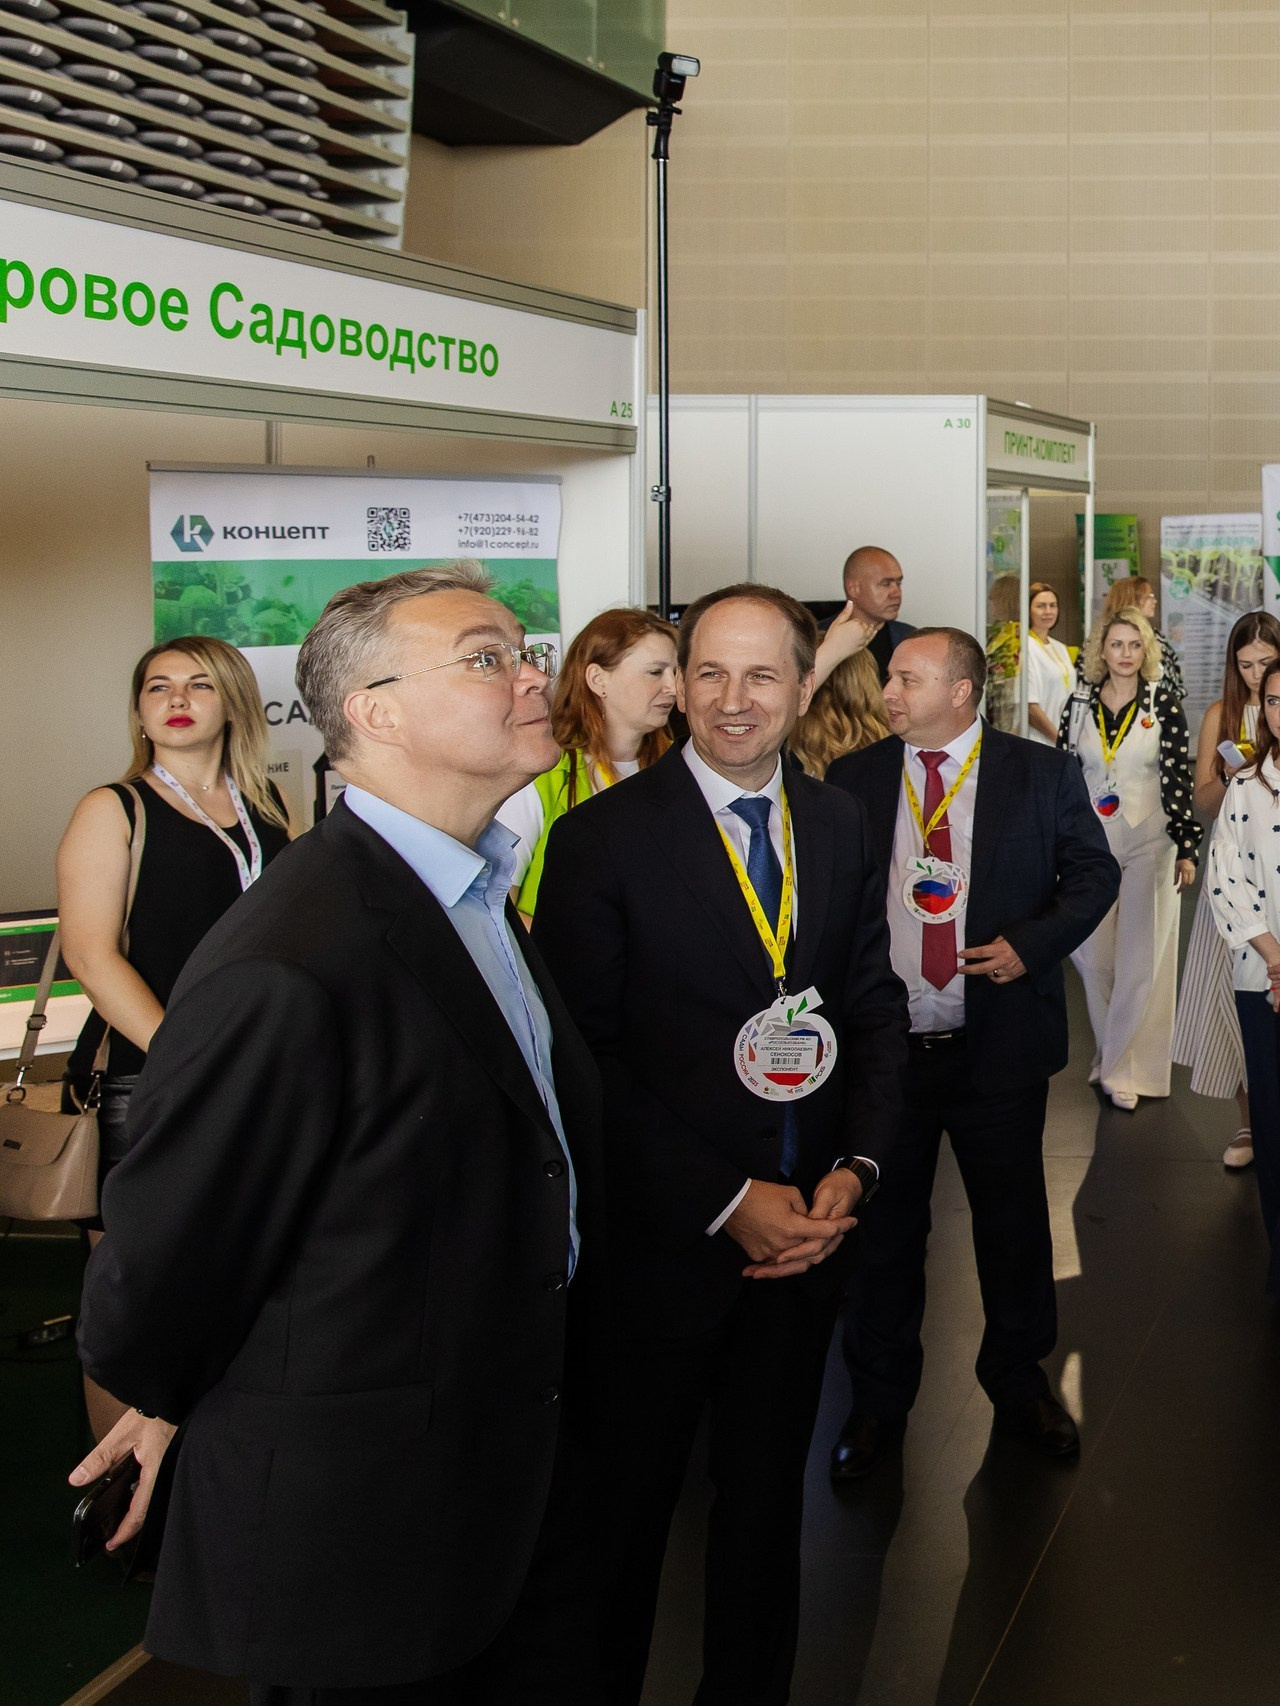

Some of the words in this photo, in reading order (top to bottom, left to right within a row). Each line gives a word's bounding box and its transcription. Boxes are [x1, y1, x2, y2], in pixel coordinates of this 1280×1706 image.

[0, 256, 189, 332] ровое
[209, 281, 500, 379] Садоводство
[622, 402, 633, 419] 25
[957, 418, 971, 428] 30
[222, 526, 330, 540] концепт
